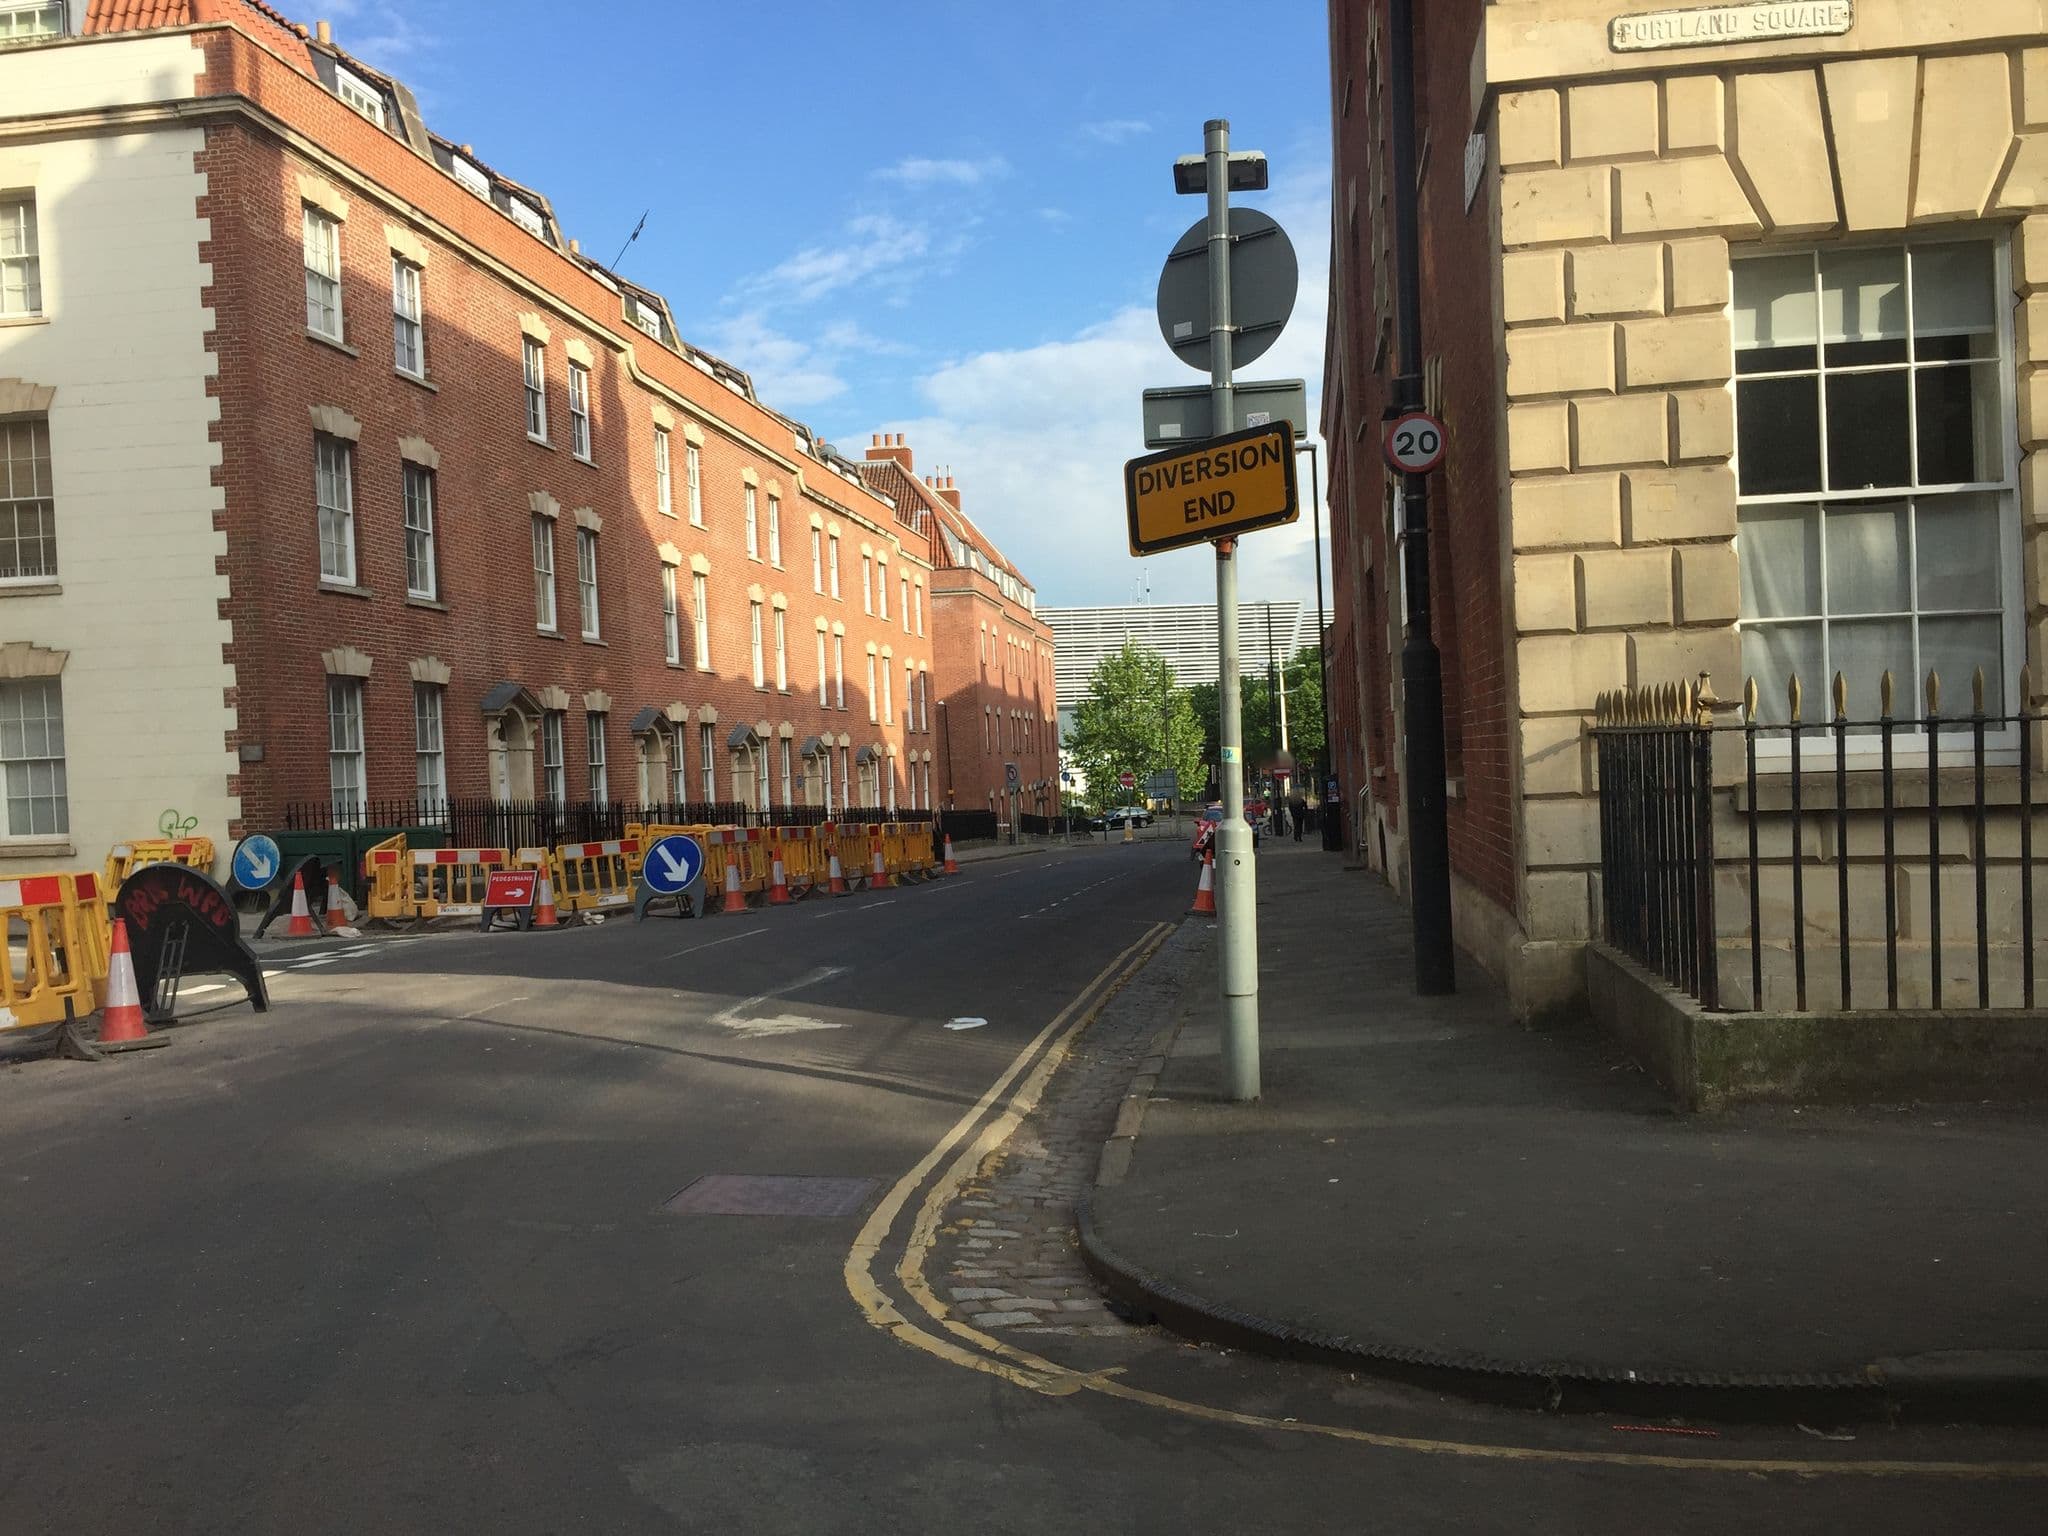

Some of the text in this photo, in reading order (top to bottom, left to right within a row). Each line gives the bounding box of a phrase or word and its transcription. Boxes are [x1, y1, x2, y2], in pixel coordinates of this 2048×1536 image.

[1619, 6, 1844, 43] PORTLAND SQUARE
[1396, 430, 1438, 456] 20
[1138, 441, 1280, 495] DIVERSION
[1183, 490, 1236, 524] END
[491, 874, 533, 883] PEDESTRIANS
